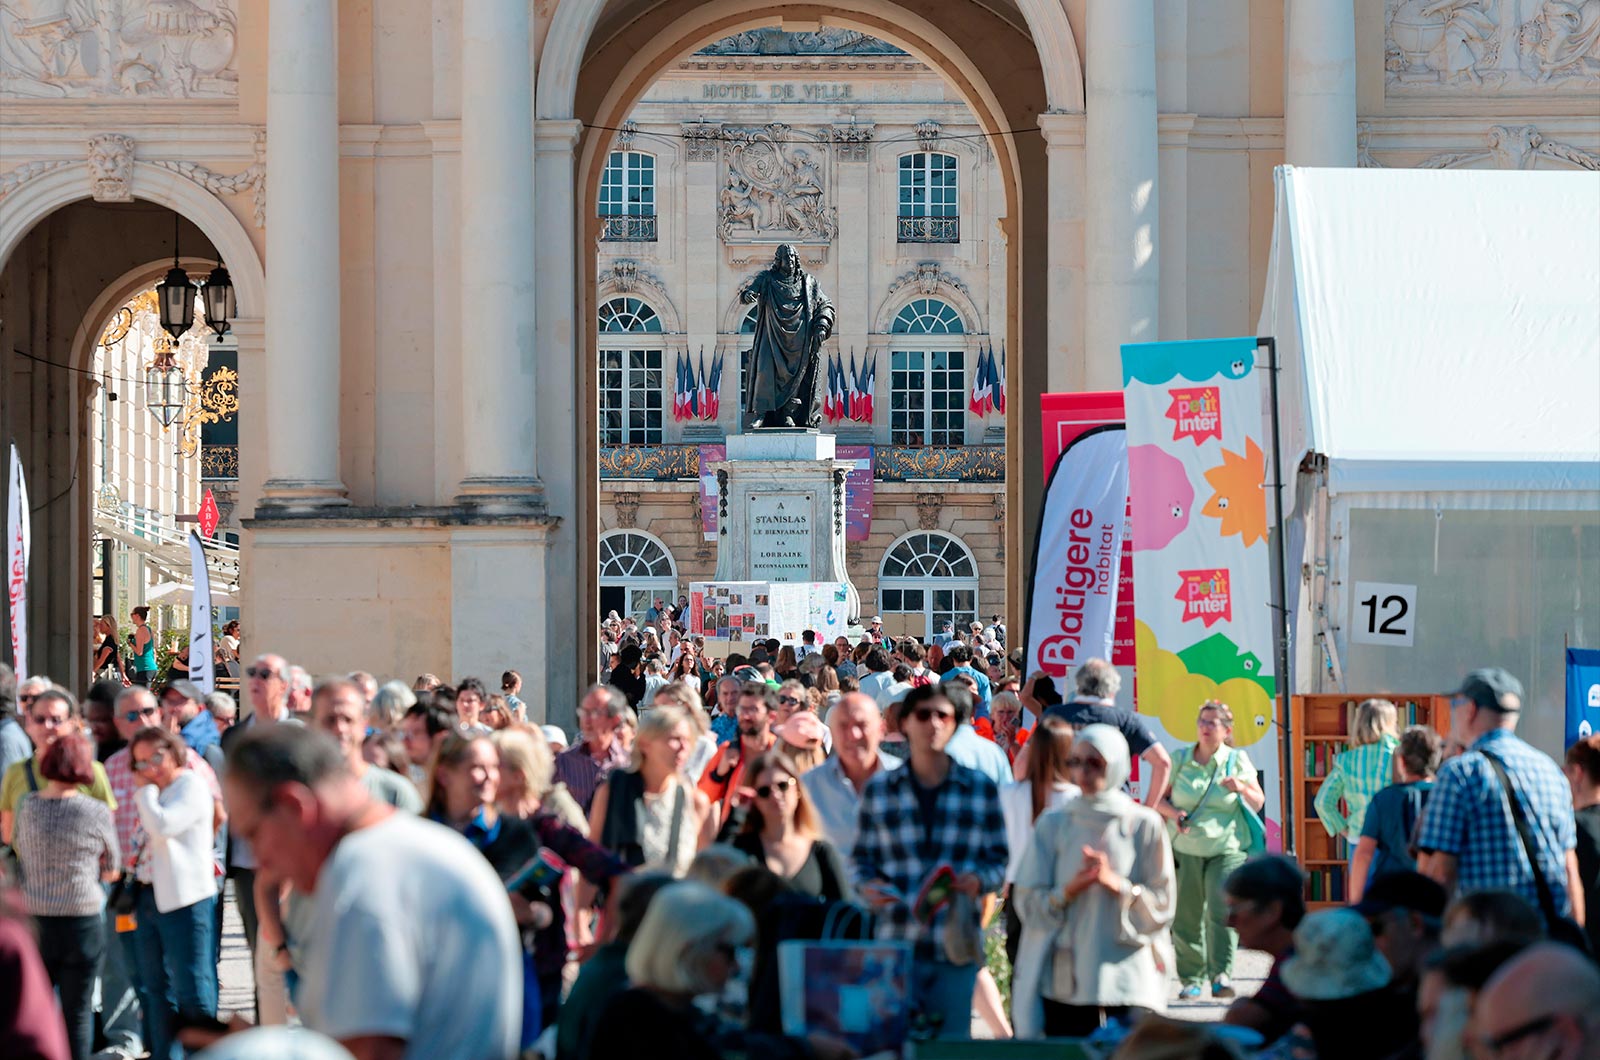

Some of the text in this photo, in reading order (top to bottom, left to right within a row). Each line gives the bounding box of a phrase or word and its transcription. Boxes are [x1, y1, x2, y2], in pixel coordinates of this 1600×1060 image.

[703, 83, 854, 98] HOTEL DE VILLE
[1178, 394, 1217, 418] petit
[1179, 415, 1218, 432] inter
[205, 497, 213, 536] TABAC
[777, 502, 784, 510] A
[755, 515, 807, 523] STANISLAS
[1093, 523, 1114, 595] habitat
[1037, 508, 1096, 678] Batigere
[1188, 577, 1228, 601] petit
[1188, 597, 1228, 614] inter
[1361, 595, 1408, 635] 12
